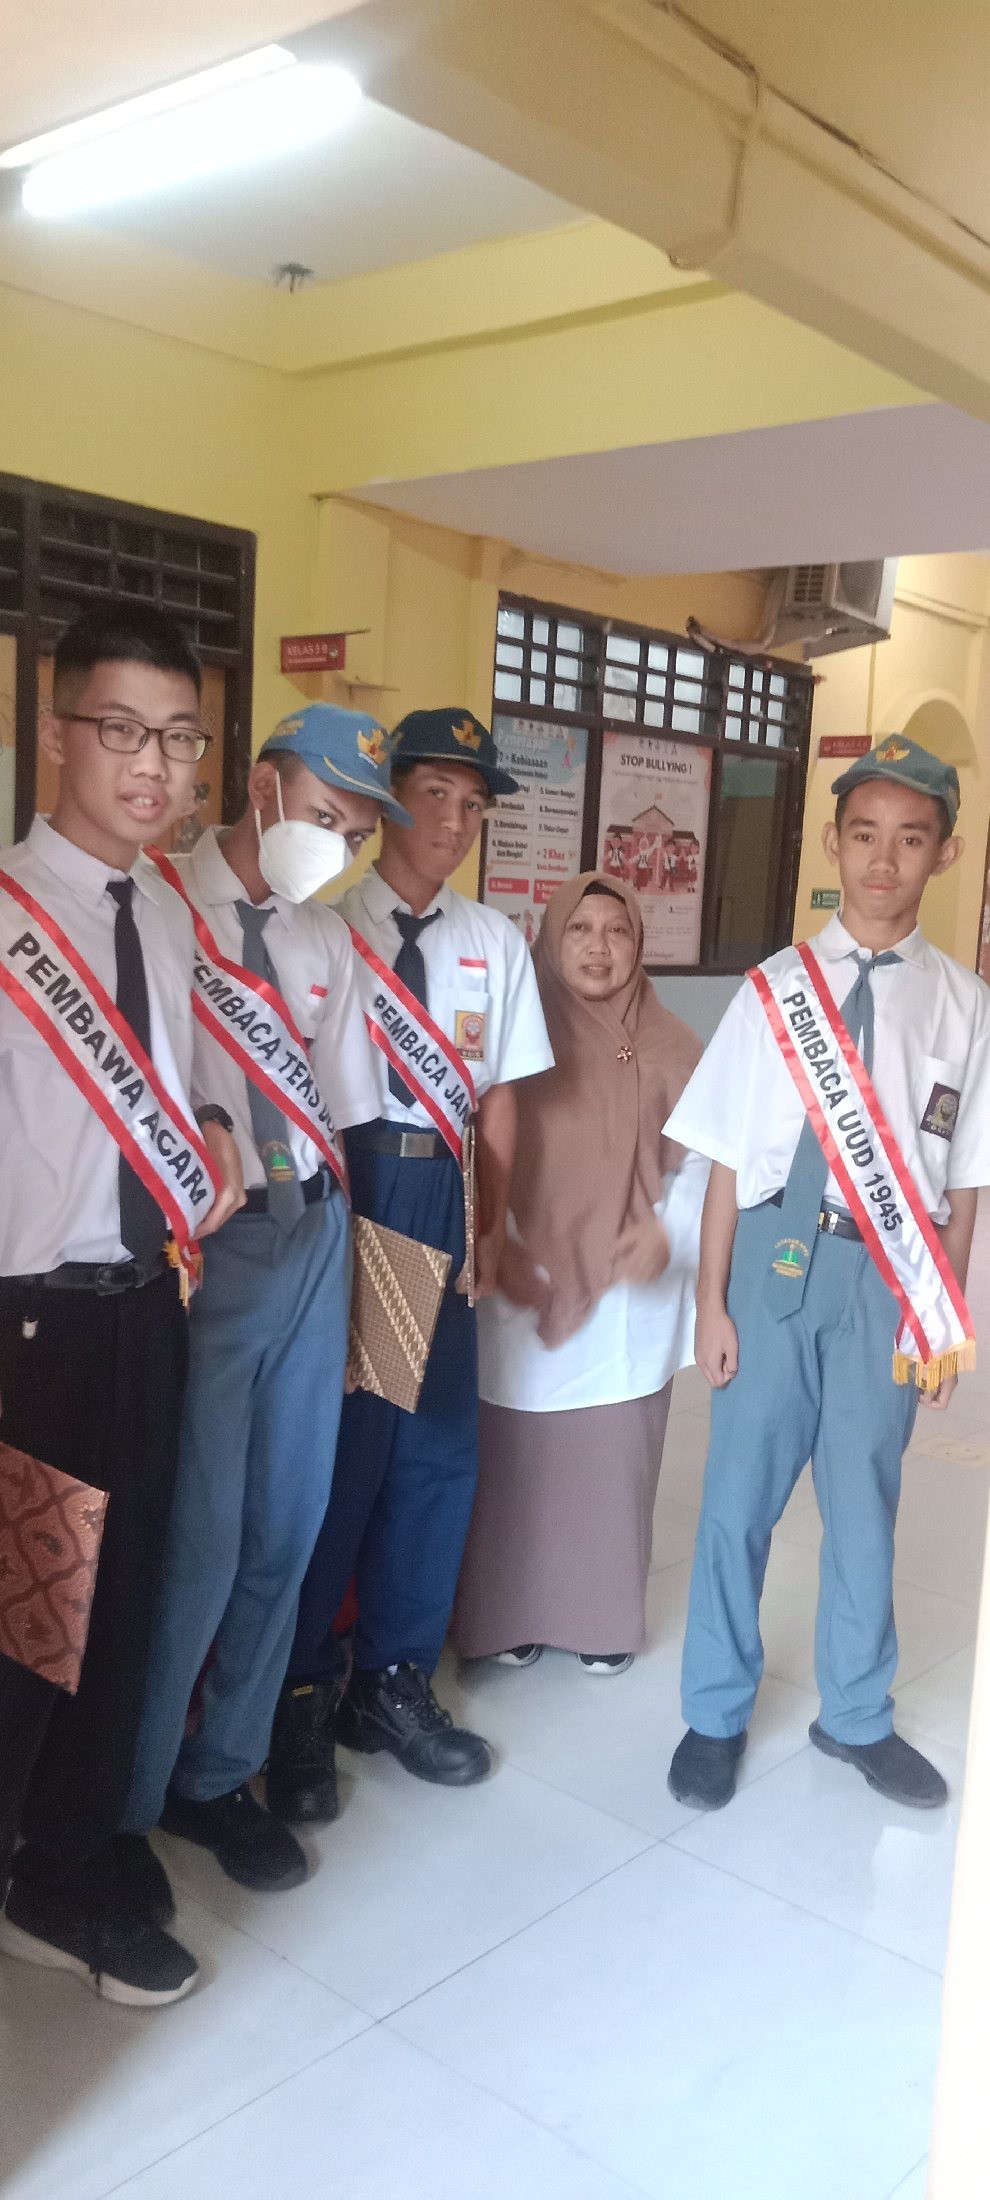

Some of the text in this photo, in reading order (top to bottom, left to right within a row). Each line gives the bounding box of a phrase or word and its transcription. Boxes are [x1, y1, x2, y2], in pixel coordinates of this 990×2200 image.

[511, 752, 548, 769] Kebiasaan
[620, 753, 645, 766] STOP
[646, 758, 688, 774] BULLYING
[7, 931, 145, 1109] PEMBAWA
[193, 949, 282, 1061] EMBACA
[278, 1049, 320, 1108] TEKS
[373, 993, 448, 1087] PEMBACA
[783, 990, 904, 1232] PEMBACA UUD 1945
